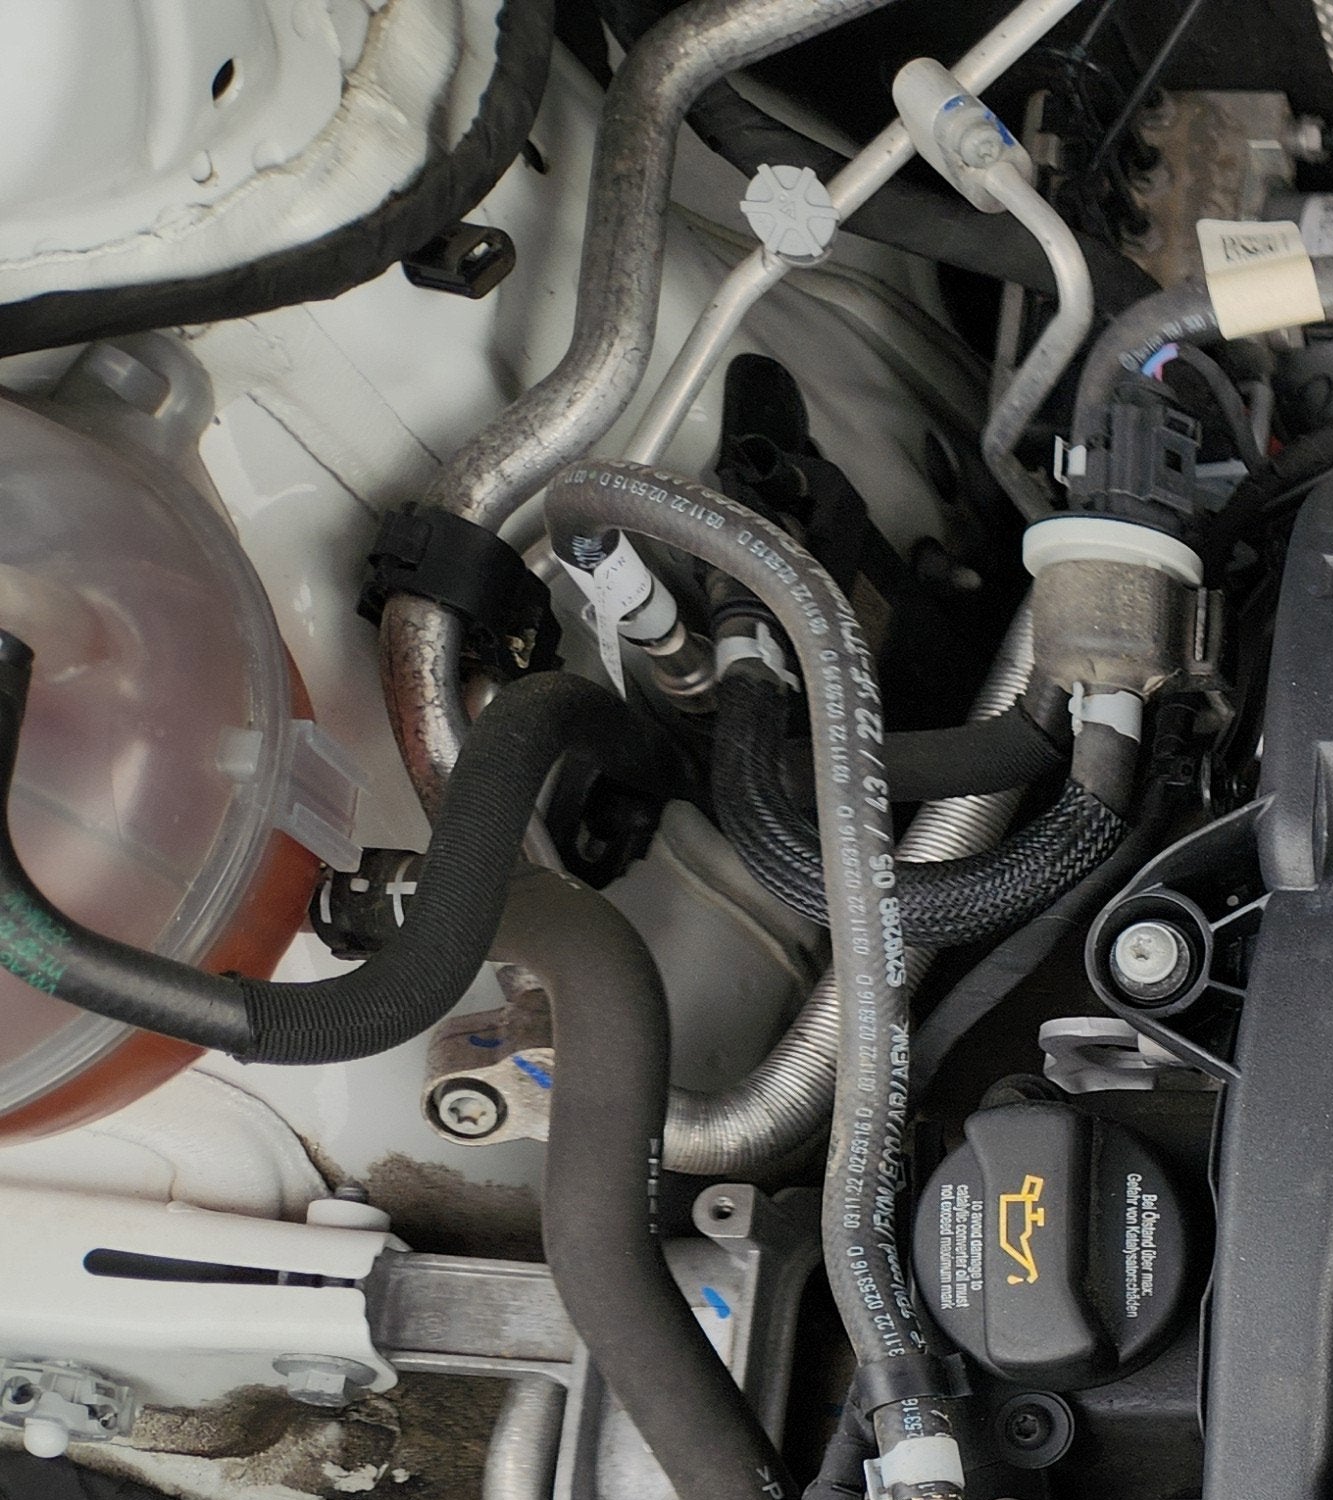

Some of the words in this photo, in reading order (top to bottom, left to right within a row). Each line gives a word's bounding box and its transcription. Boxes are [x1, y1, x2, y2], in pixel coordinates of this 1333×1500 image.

[599, 471, 611, 487] D
[837, 805, 856, 818] D
[856, 974, 874, 986] D
[857, 1107, 875, 1118] D
[940, 1184, 954, 1201] not
[1125, 1173, 1143, 1206] Gefahr
[952, 1184, 971, 1223] catalytic
[1125, 1206, 1138, 1224] von
[939, 1202, 954, 1235] exceed
[970, 1212, 983, 1238] avoid
[846, 1245, 865, 1257] D
[939, 1236, 954, 1283] maximum
[955, 1224, 969, 1269] converter
[967, 1239, 983, 1279] damage
[1122, 1225, 1141, 1318] Katalysatorschäden
[940, 1284, 955, 1310] mark
[955, 1283, 970, 1308] must
[970, 1280, 983, 1291] to
[873, 1313, 906, 1358] 3.11.22
